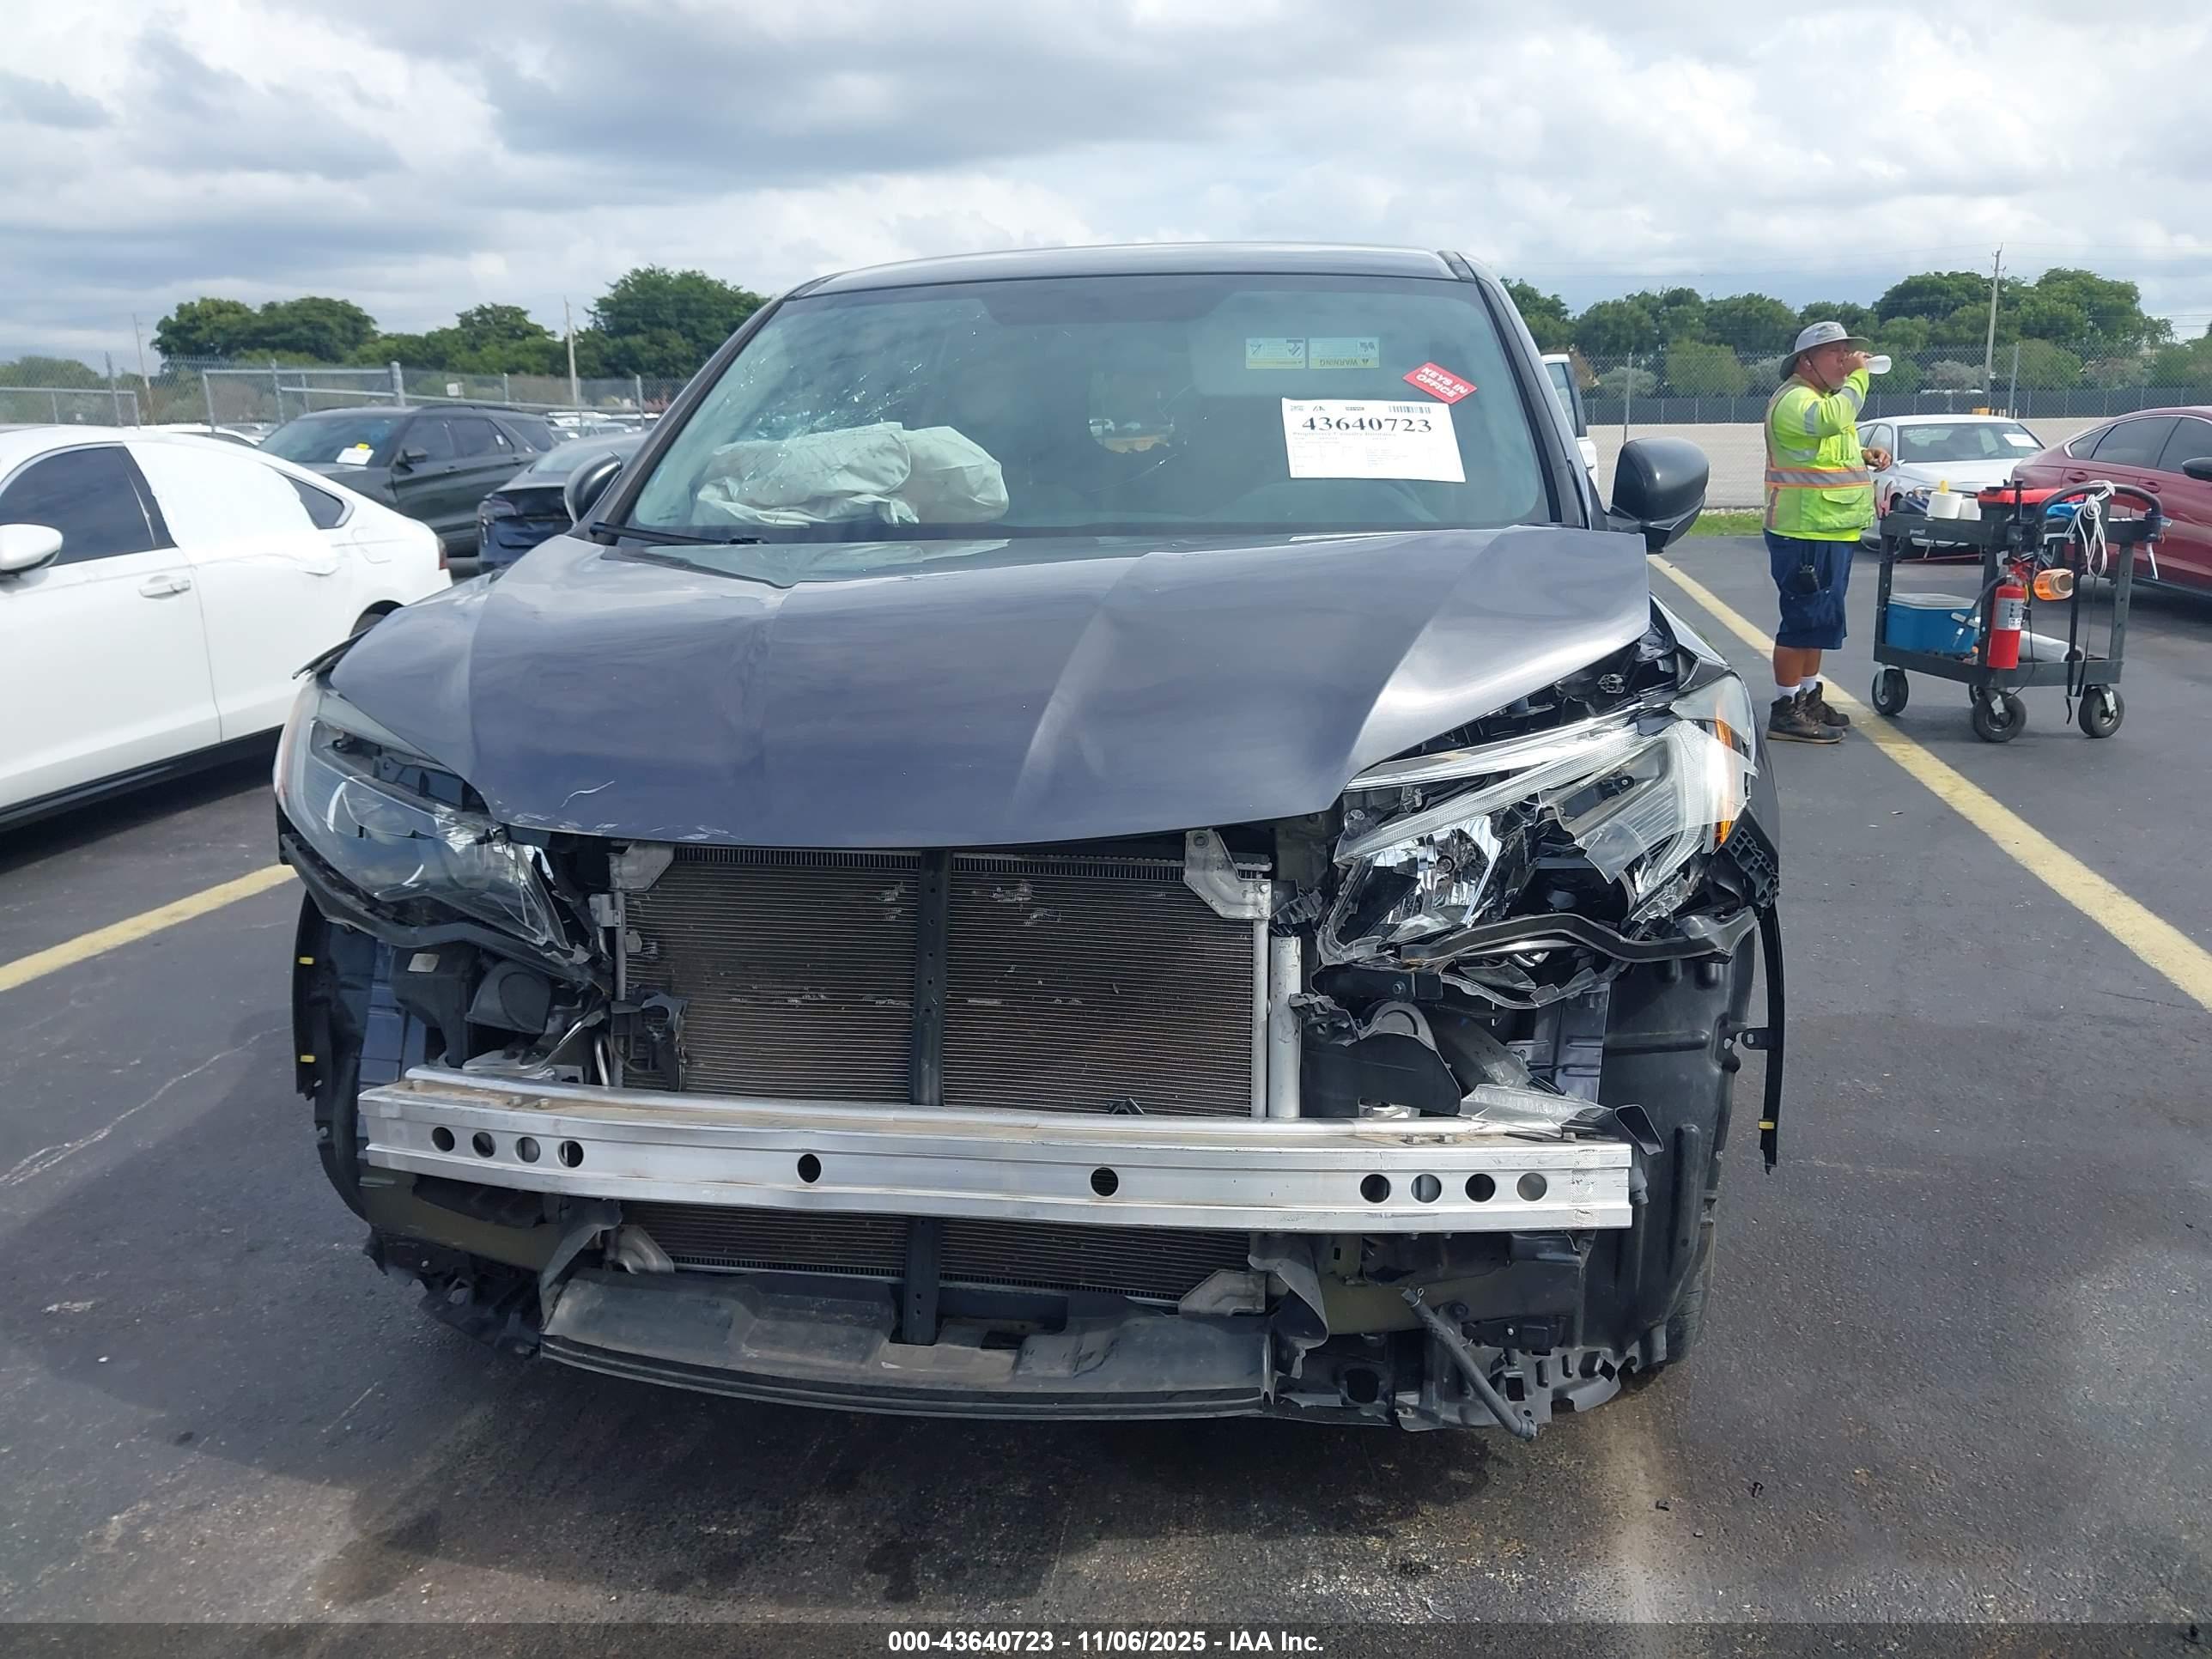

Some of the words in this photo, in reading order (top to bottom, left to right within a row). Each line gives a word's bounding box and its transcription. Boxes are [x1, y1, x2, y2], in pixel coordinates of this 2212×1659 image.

[1319, 358, 1358, 367] WARNING
[1415, 374, 1457, 398] OFFICE
[1420, 368, 1453, 386] KEYS
[1452, 384, 1468, 394] IN
[1302, 416, 1432, 433] 43640723
